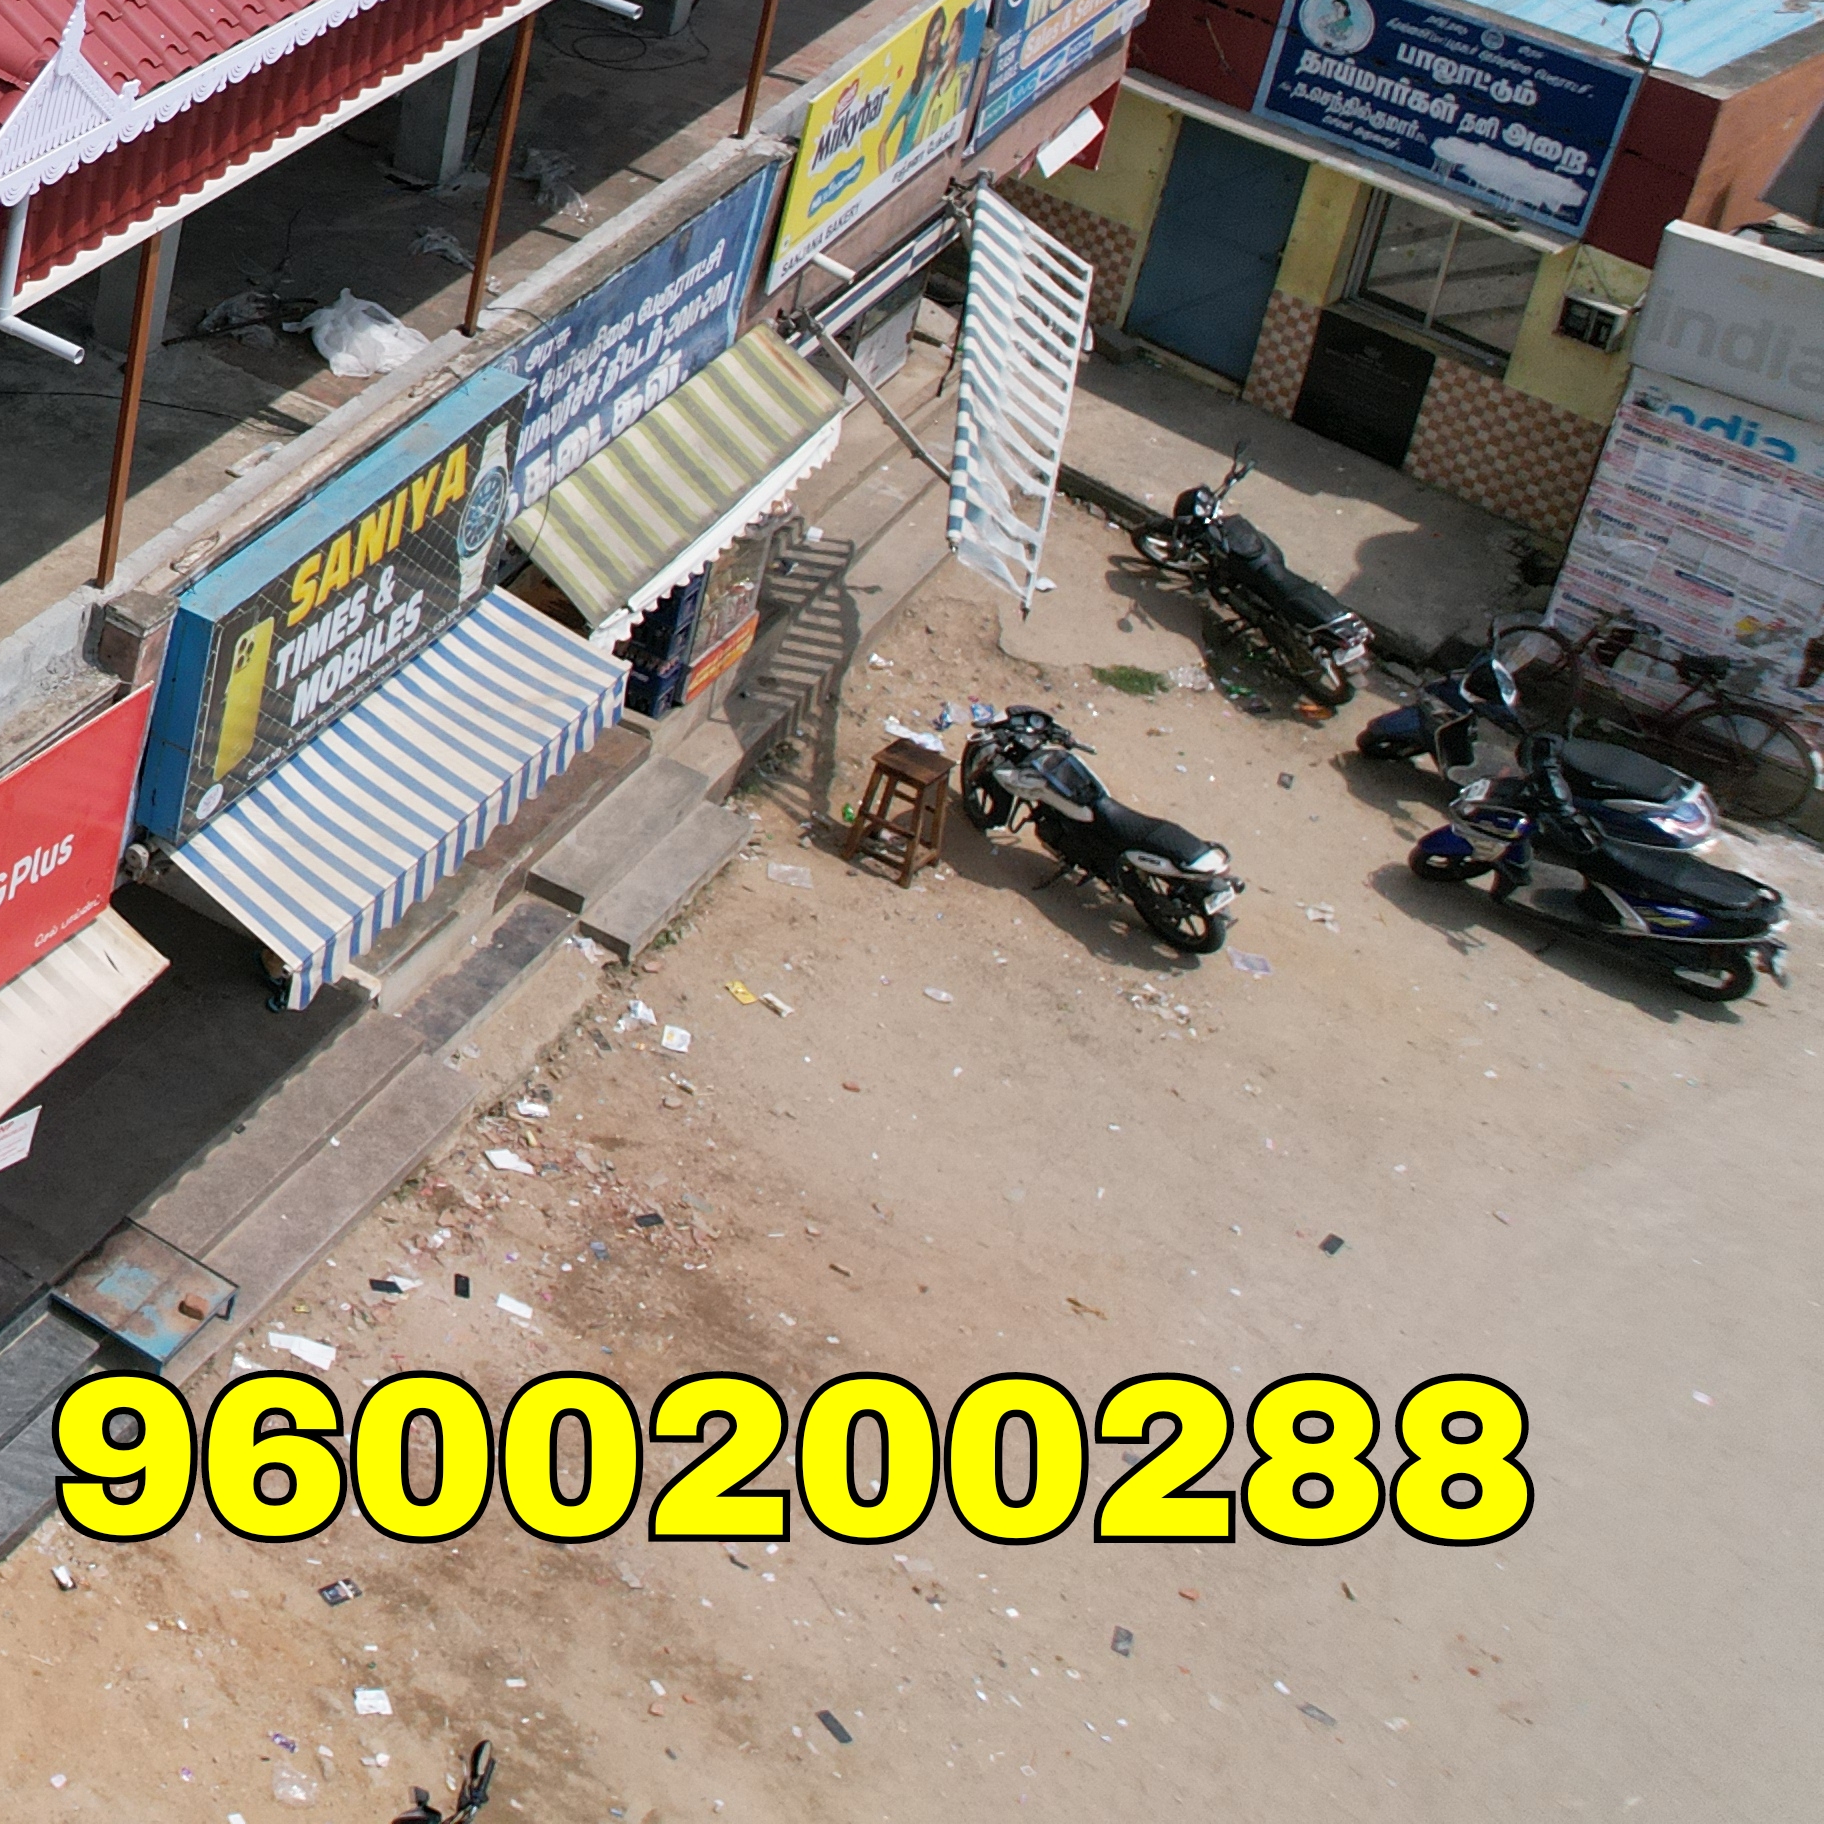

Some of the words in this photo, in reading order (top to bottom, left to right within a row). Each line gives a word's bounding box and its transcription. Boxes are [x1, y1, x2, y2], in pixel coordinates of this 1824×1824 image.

[1024, 18, 1060, 58] Sales
[1396, 41, 1539, 107] பாலூட்டும்
[811, 83, 891, 170] Milkybar
[1296, 47, 1460, 125] தாய்மார்கள்
[1457, 112, 1501, 142] தனி
[780, 230, 823, 277] SANJANA
[823, 202, 862, 239] BAKERY
[525, 327, 571, 372] அரசு
[540, 312, 634, 403] தேர்வுநிலை
[637, 237, 726, 326] பேரூராட்சி
[287, 444, 468, 627] SANIYA
[276, 584, 369, 690] TIMES
[373, 565, 395, 612] &
[290, 589, 424, 727] MOBILES
